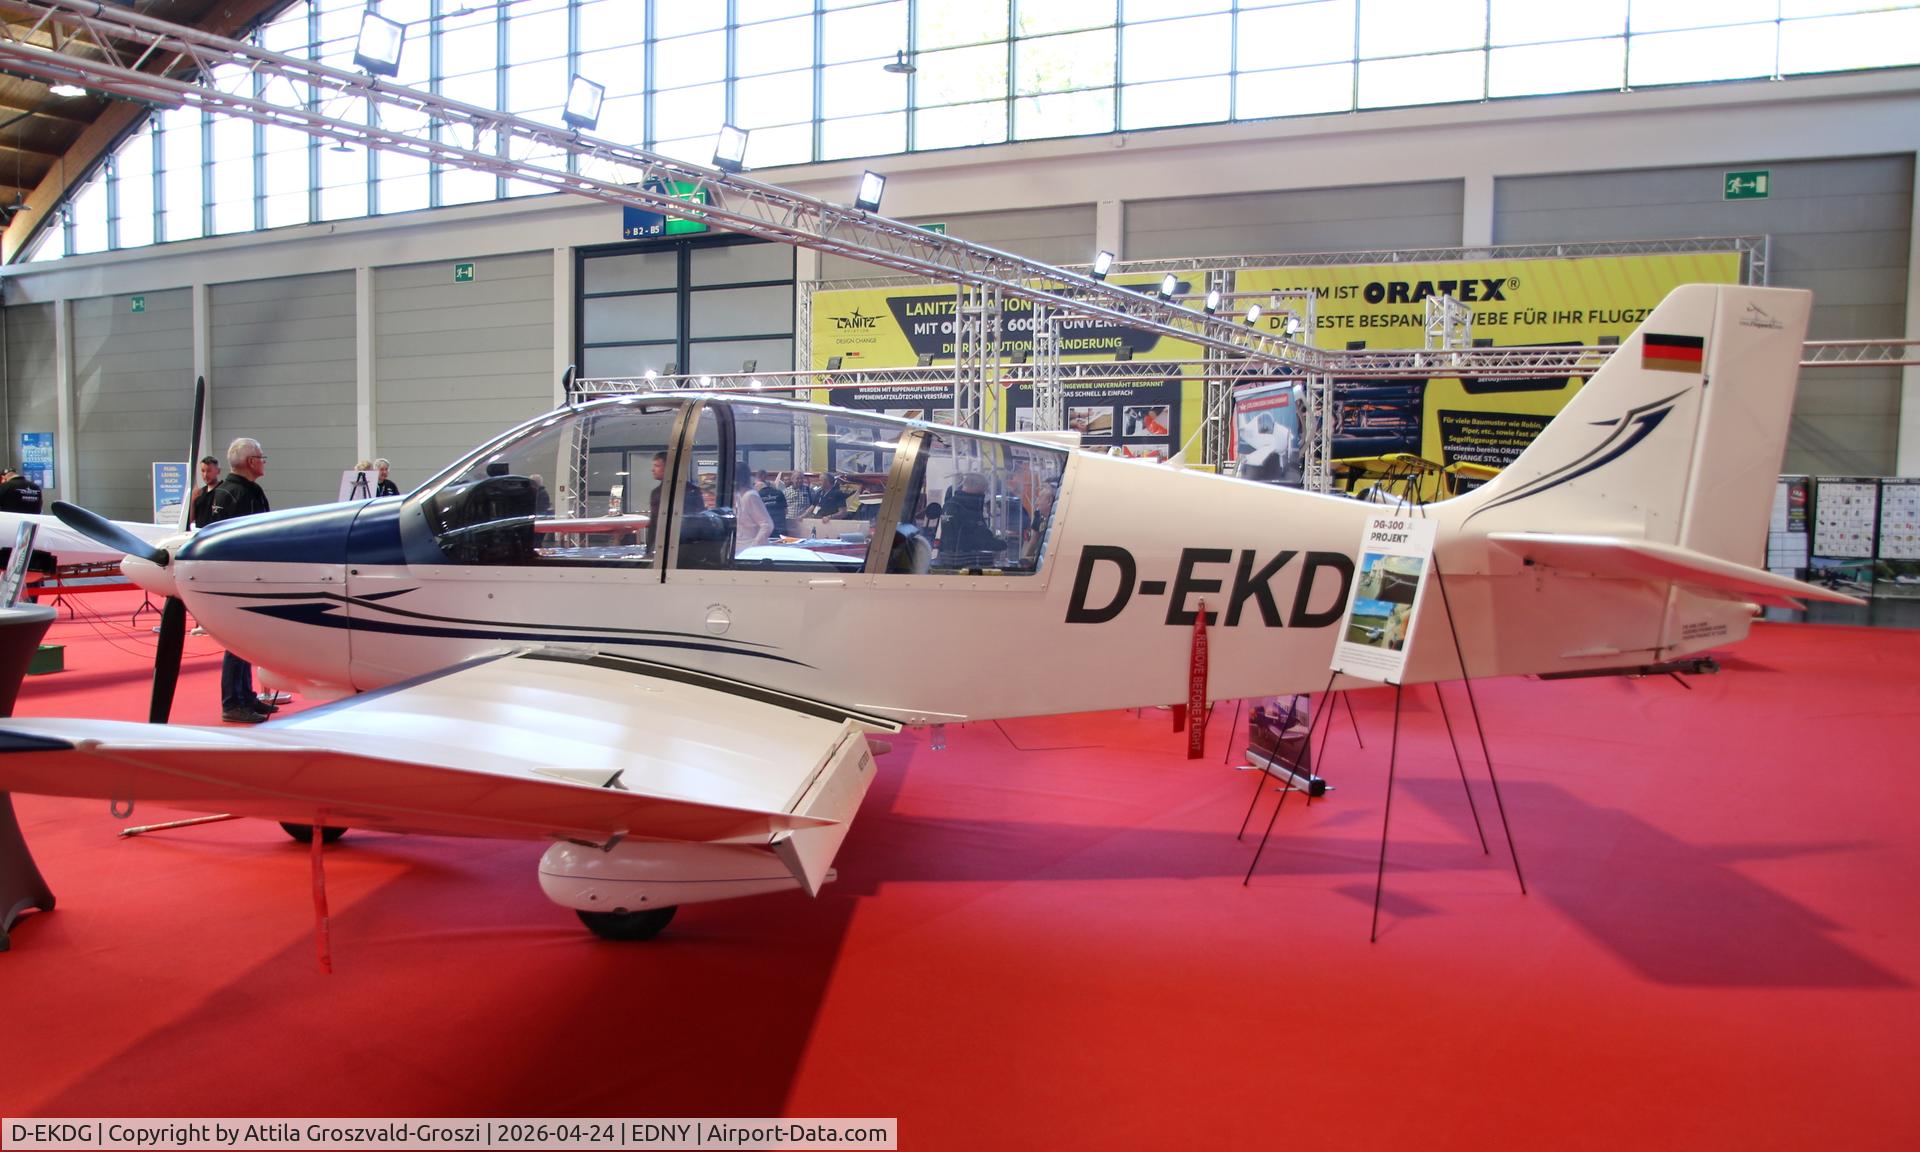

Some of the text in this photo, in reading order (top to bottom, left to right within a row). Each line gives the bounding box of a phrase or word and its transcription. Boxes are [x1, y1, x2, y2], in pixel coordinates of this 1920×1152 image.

[1335, 286, 1359, 299] IST
[906, 301, 957, 316] LANITZ
[837, 317, 876, 328] LANITZ
[1316, 315, 1355, 328] ESTE
[1513, 308, 1548, 325] FÜR
[1552, 310, 1582, 324] IHR
[914, 322, 938, 335] MIT
[1093, 381, 1131, 389] UNVERNÄHT
[1443, 416, 1454, 424] Für
[1455, 417, 1471, 425] viele
[1471, 418, 1507, 427] Baumuster
[1449, 434, 1498, 446] Segelflugzeuge
[1499, 438, 1512, 446] und
[1443, 445, 1475, 453] existieren
[1476, 446, 1500, 454] bereits
[1453, 453, 1482, 462] CHANGE
[1373, 519, 1404, 530] DG-300
[1370, 531, 1408, 543] PROJEKT
[1190, 634, 1207, 750] REMOVE BEFORE FLIGHT
